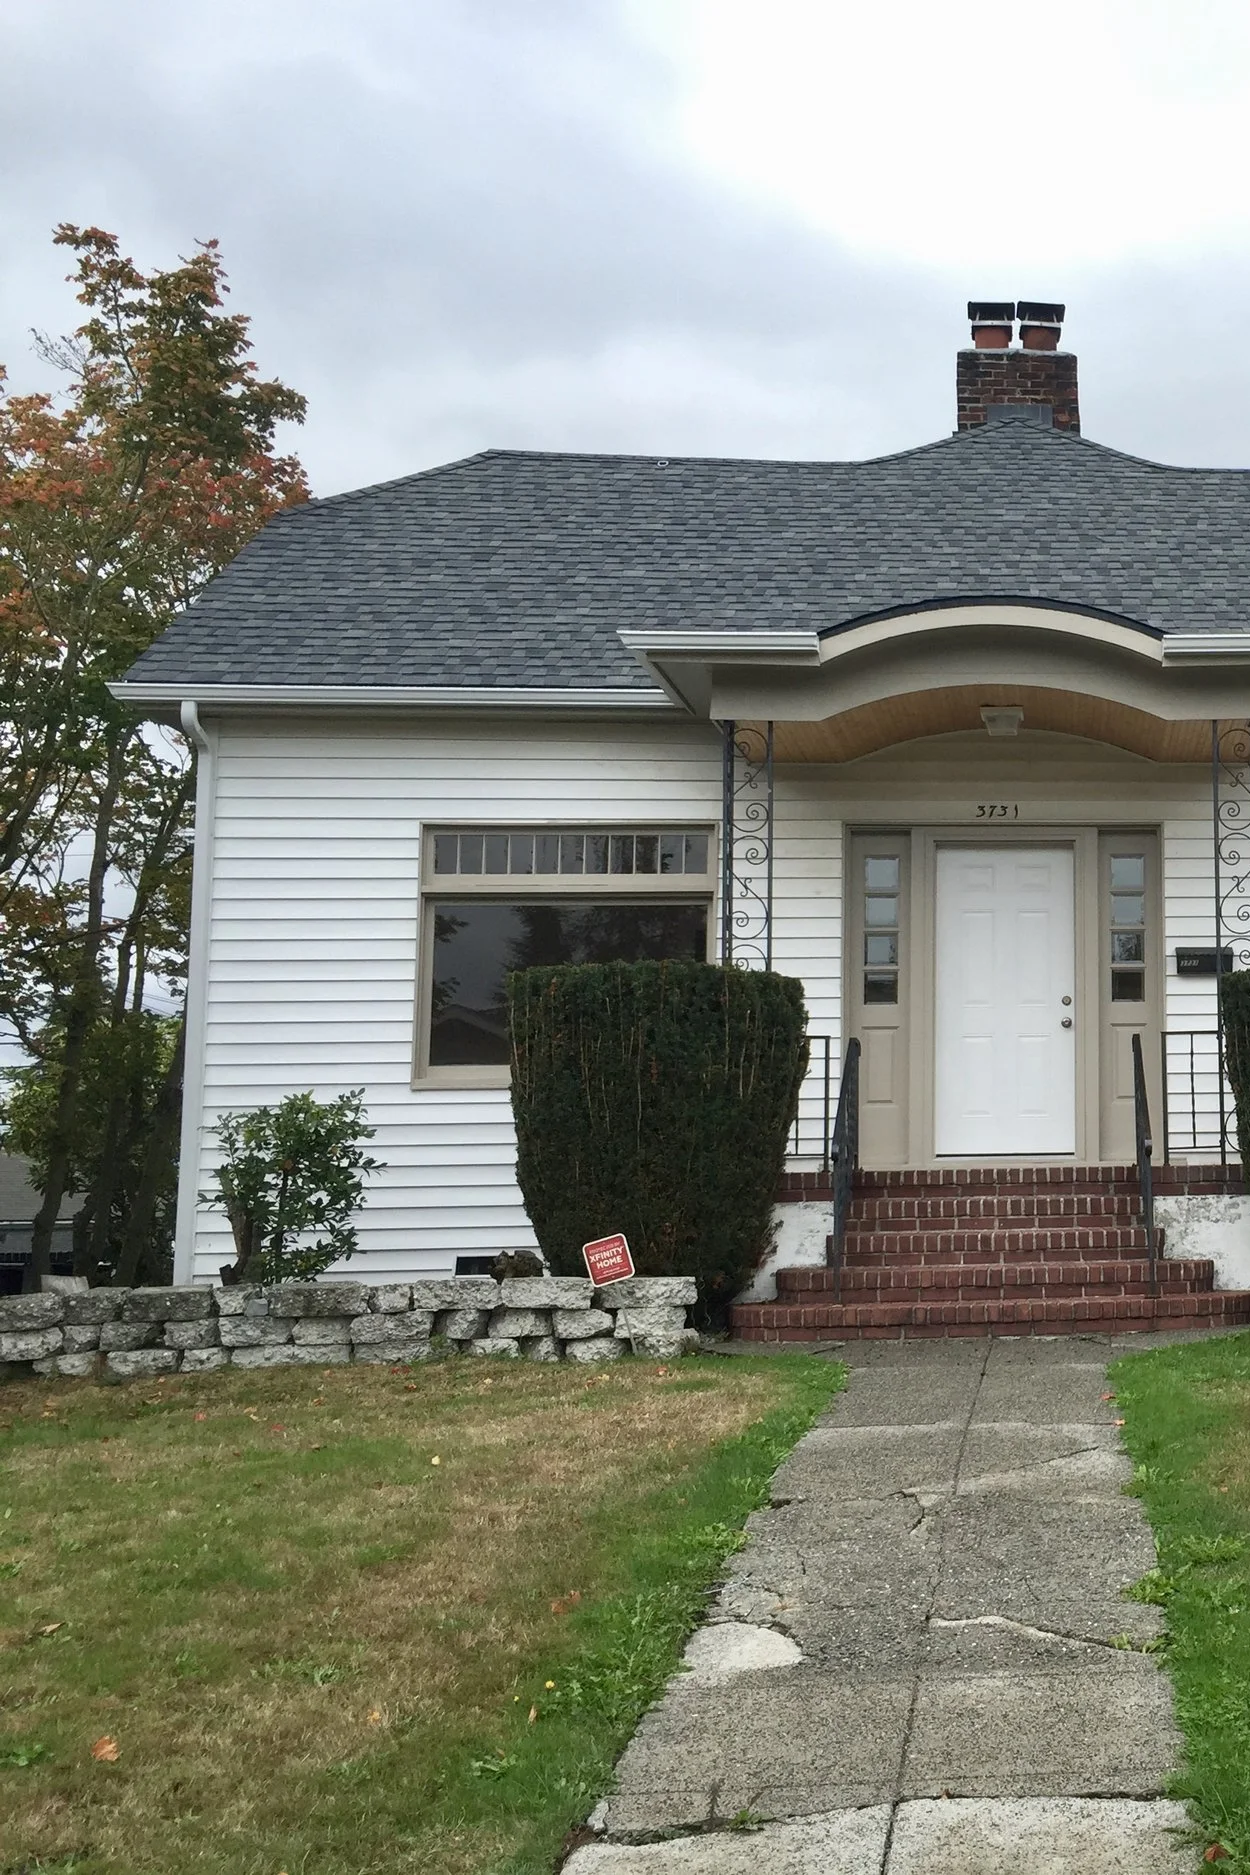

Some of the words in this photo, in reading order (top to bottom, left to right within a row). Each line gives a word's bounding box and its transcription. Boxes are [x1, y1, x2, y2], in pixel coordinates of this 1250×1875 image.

[976, 804, 1019, 819] 3731
[589, 1246, 624, 1263] XFINITY
[596, 1255, 623, 1269] HOME
